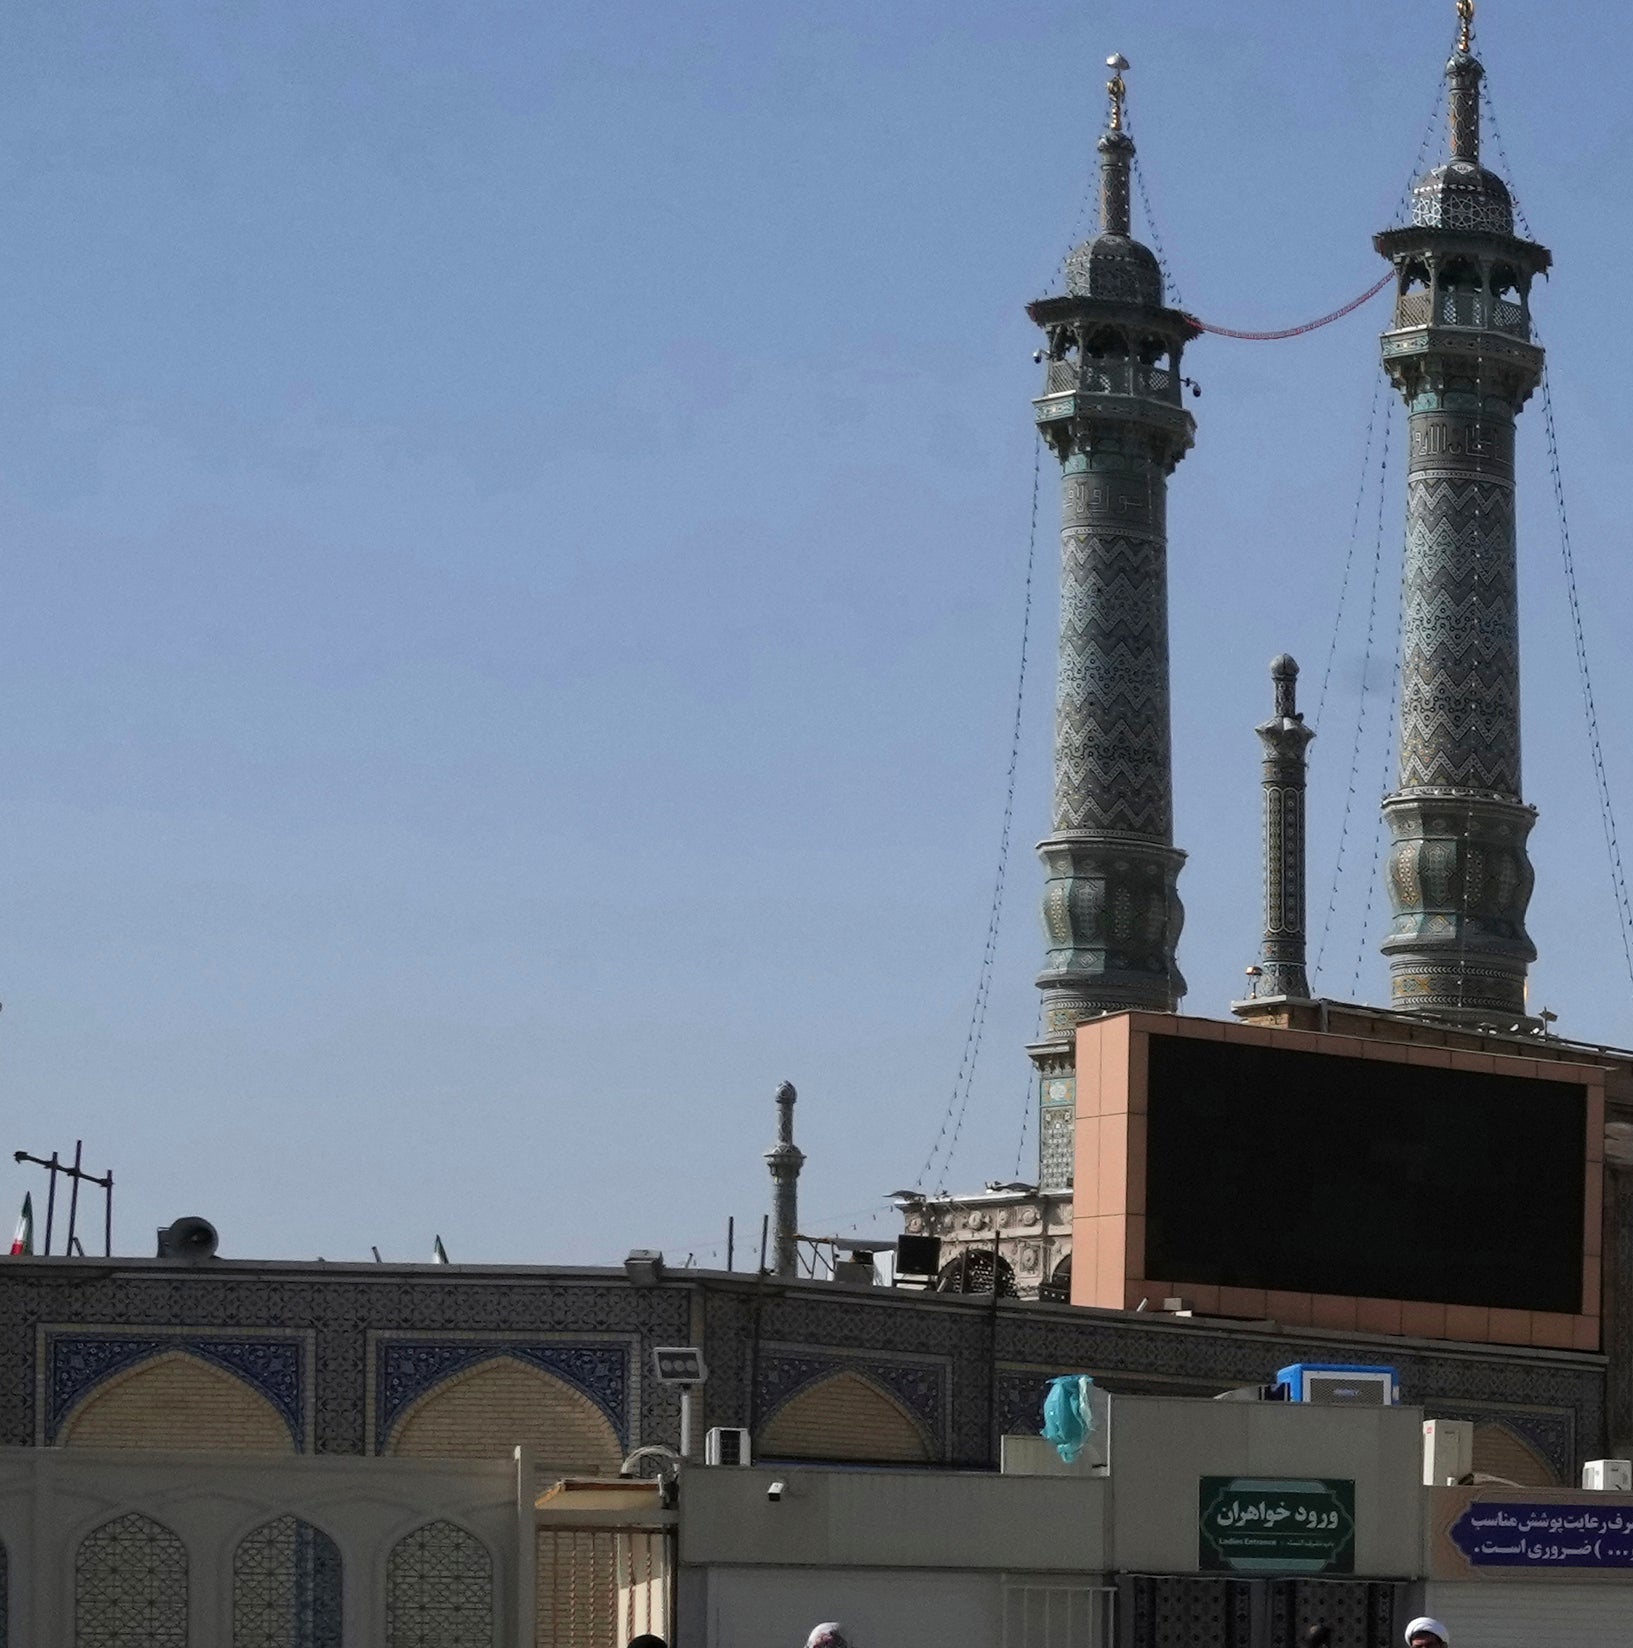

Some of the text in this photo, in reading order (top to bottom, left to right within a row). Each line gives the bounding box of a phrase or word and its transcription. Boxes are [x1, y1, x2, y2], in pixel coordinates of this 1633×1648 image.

[1216, 1500, 1340, 1529] ورود خواهران
[1470, 1510, 1519, 1532] مناسب
[1518, 1511, 1563, 1534] پوشش
[1562, 1512, 1607, 1535] رعایت
[1527, 1540, 1593, 1560] ضروری
